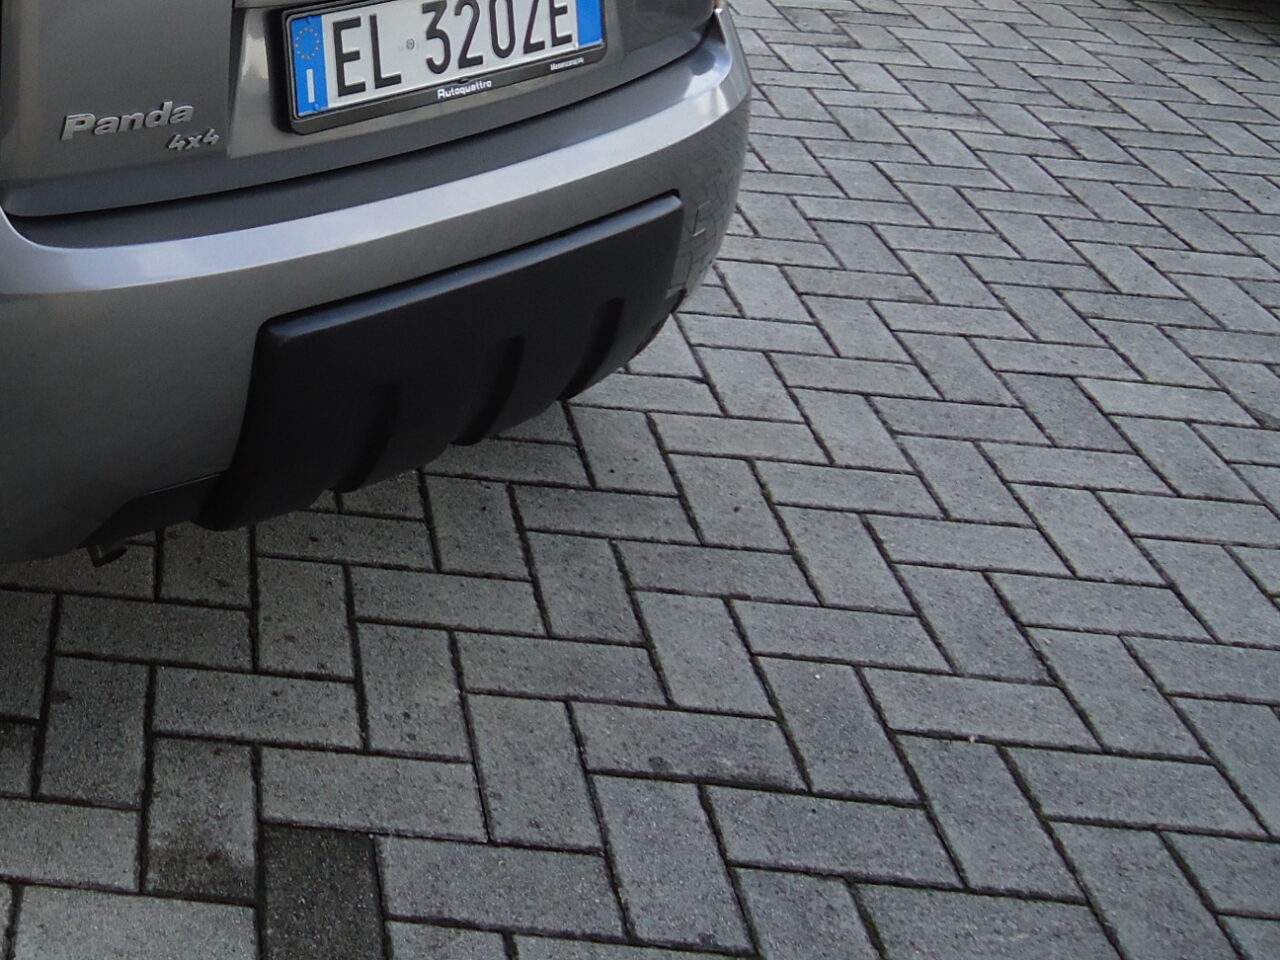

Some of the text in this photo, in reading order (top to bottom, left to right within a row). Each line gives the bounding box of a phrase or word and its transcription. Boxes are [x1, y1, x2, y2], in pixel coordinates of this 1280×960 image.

[332, 9, 402, 97] EL
[437, 80, 493, 100] Autoquattro
[60, 100, 194, 141] Panda
[168, 128, 220, 151] 4x4
